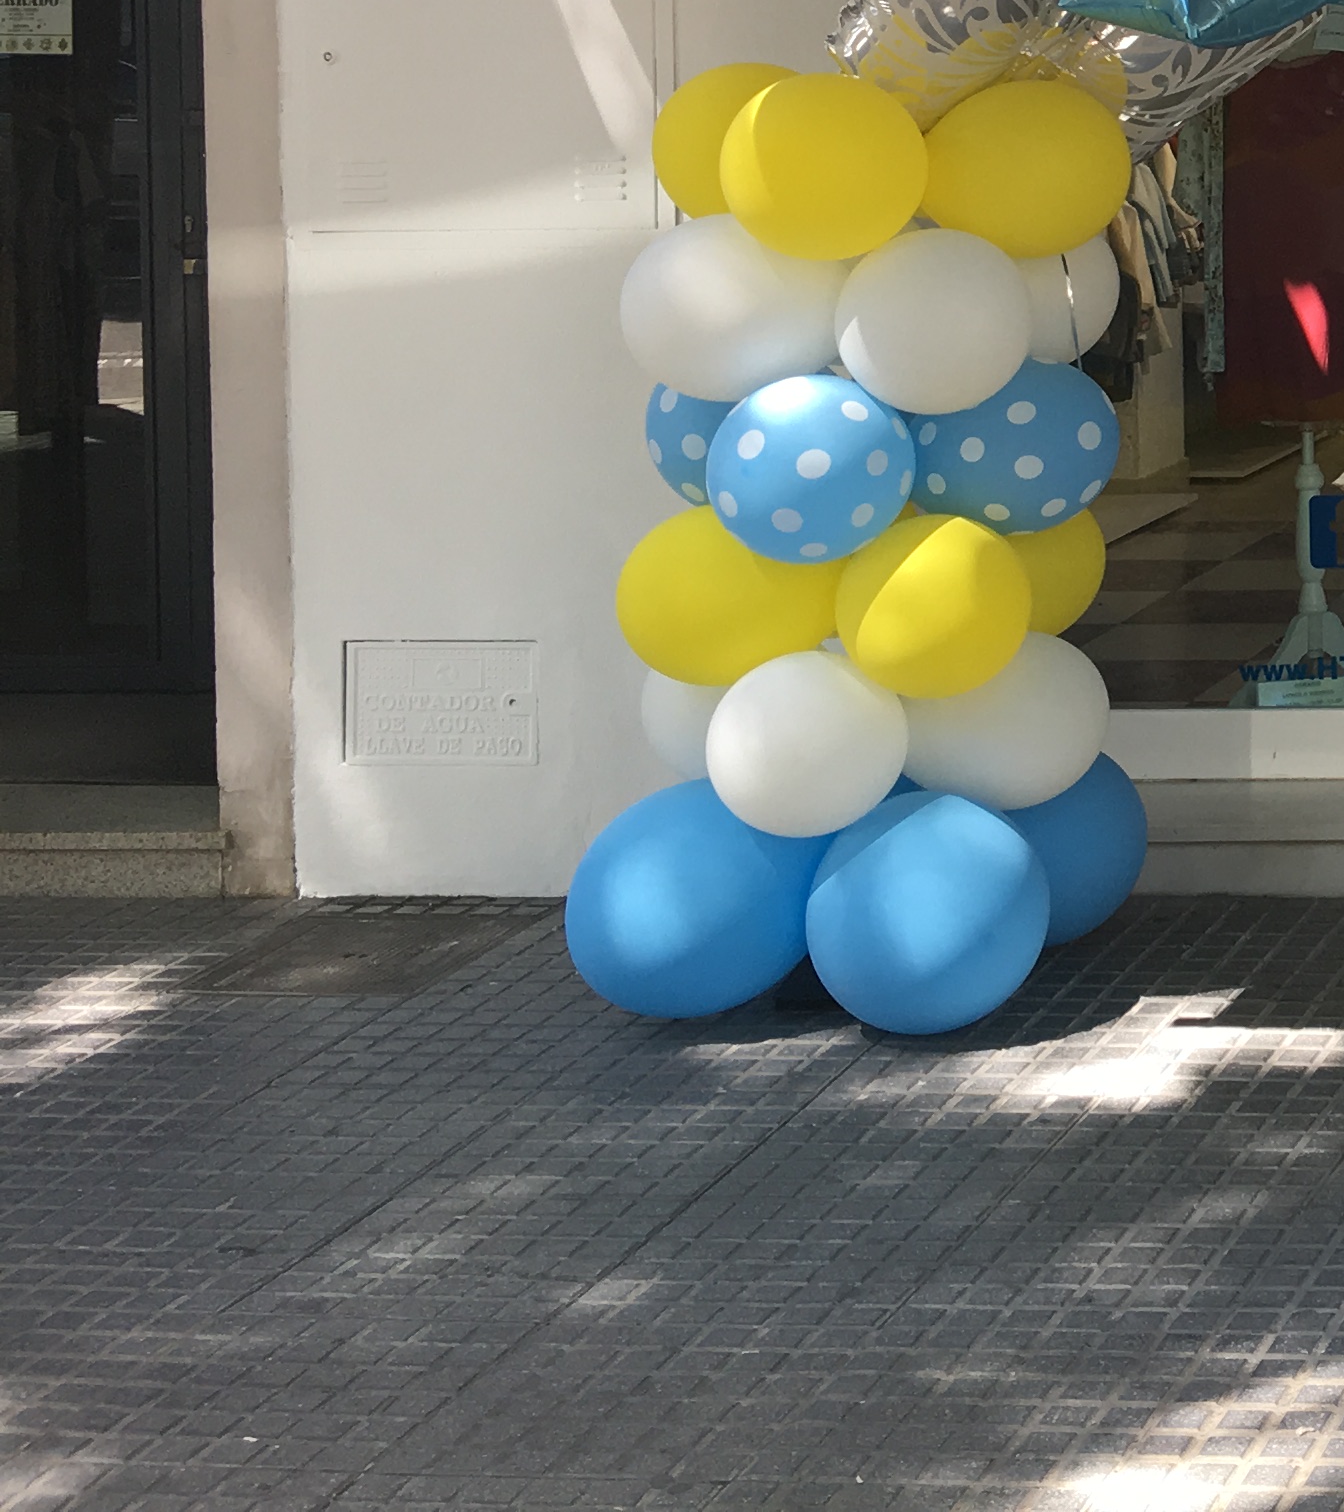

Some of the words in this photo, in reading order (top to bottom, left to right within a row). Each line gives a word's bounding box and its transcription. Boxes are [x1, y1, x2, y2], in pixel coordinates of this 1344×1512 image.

[365, 694, 497, 712] CONTADOR
[376, 717, 406, 734] DE
[422, 717, 485, 734] AGUA
[365, 738, 425, 755] LLAVE
[437, 738, 461, 755] DE
